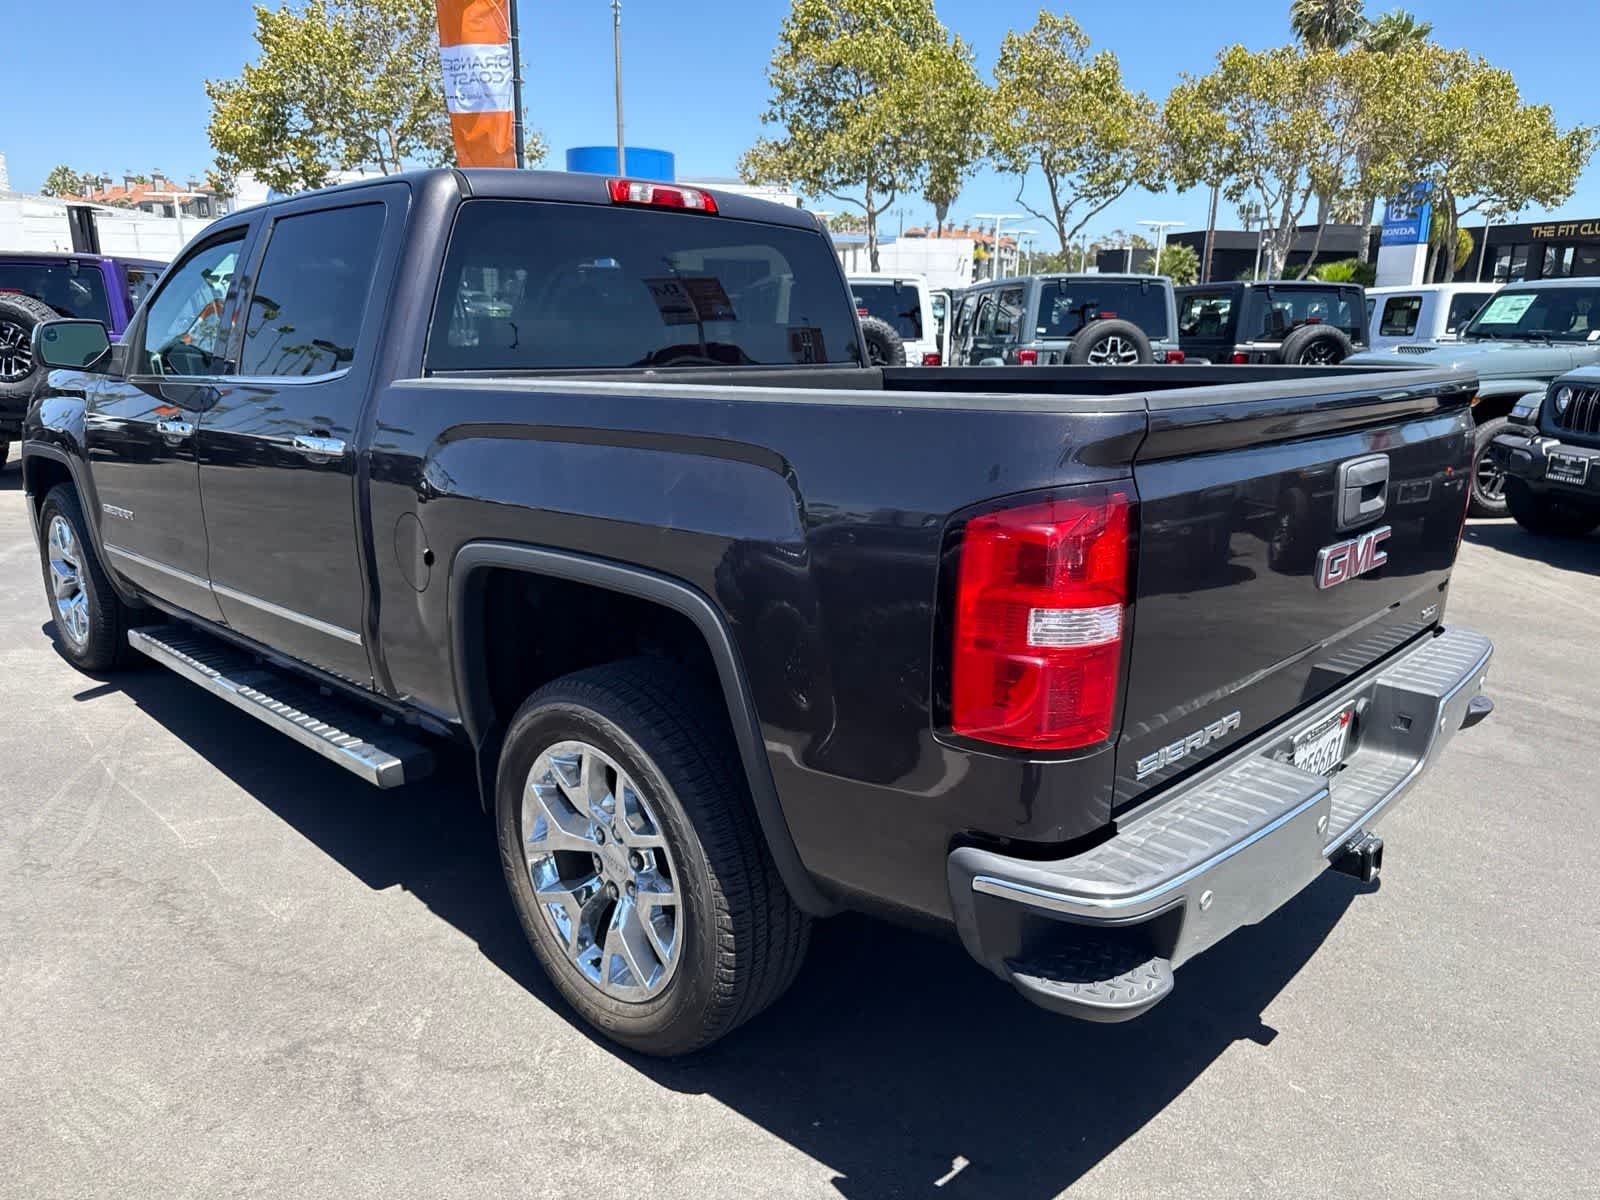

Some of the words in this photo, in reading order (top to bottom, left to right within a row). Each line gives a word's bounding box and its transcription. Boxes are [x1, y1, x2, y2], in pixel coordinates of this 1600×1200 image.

[1531, 225, 1556, 238] THE
[1557, 223, 1579, 236] FIT
[1318, 525, 1392, 589] GMC
[1136, 710, 1241, 780] SIERRA
